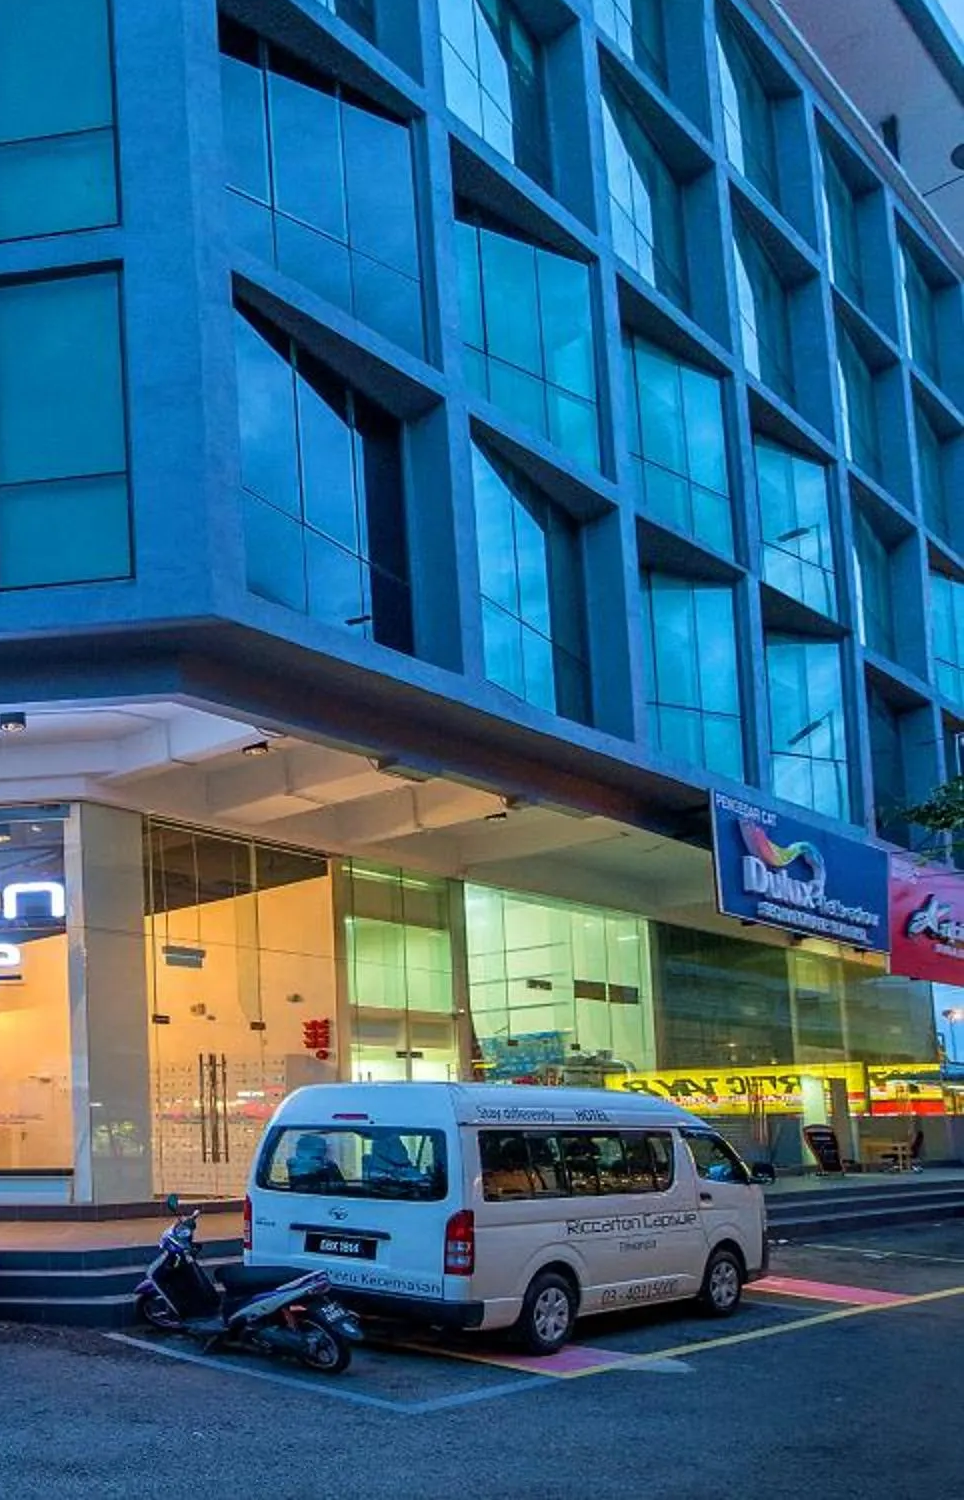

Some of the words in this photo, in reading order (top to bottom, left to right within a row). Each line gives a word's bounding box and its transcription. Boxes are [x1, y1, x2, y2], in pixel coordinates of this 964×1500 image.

[761, 811, 778, 828] CAT
[742, 855, 816, 909] Dulux
[574, 1109, 610, 1122] HOTEL
[566, 1216, 641, 1235] Riccarton
[643, 1212, 697, 1229] Capsule
[360, 1273, 441, 1294] Kecemasan
